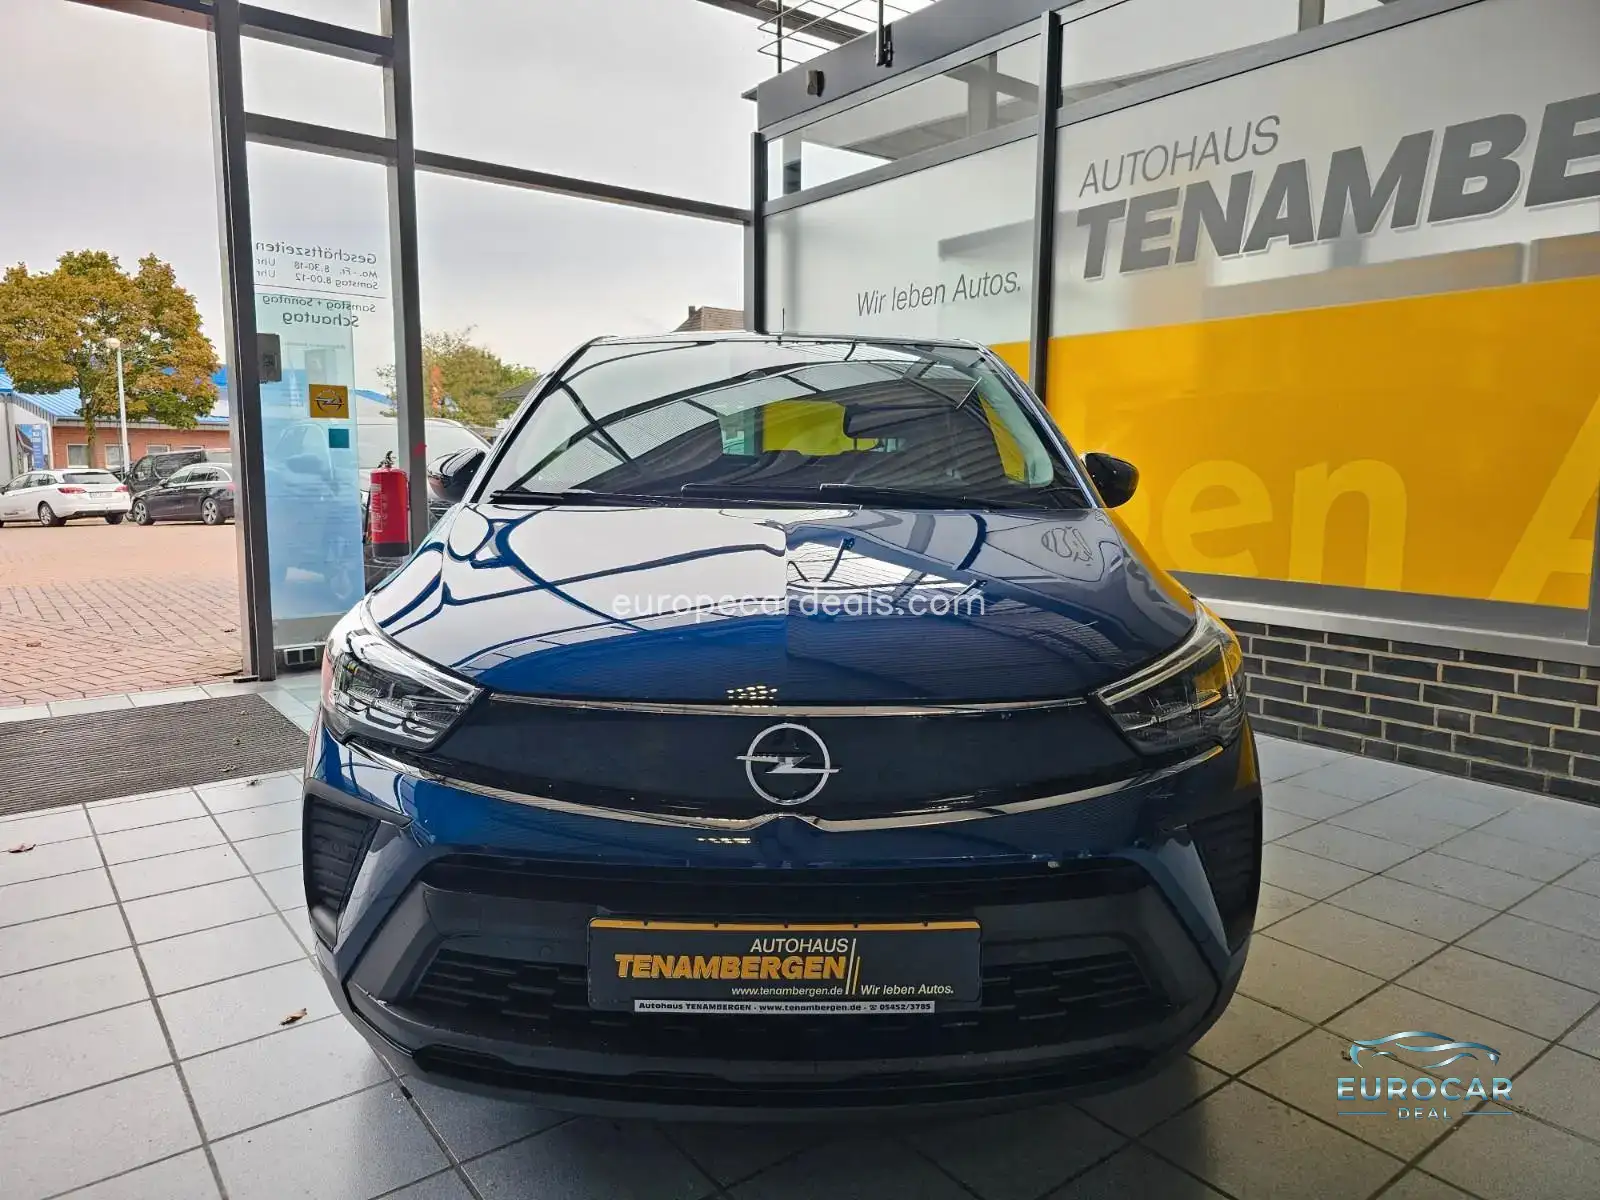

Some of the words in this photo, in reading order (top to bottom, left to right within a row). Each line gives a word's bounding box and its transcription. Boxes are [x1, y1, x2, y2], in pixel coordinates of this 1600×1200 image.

[1079, 115, 1280, 197] AUTOHAUS
[857, 290, 886, 317] Wir
[892, 283, 946, 312] leben
[952, 271, 1021, 302] Autos.
[750, 938, 849, 954] AUTOHAUS
[614, 954, 846, 981] TENAMBERGEN
[731, 985, 843, 996] www.tenambergen.de
[860, 984, 880, 995] Wir
[882, 984, 915, 995] leben
[917, 983, 954, 995] Autos.
[639, 1002, 684, 1010] Autohaus
[685, 1003, 752, 1011] TENAMBERGEN
[759, 1003, 861, 1012] www.tenambergen.de
